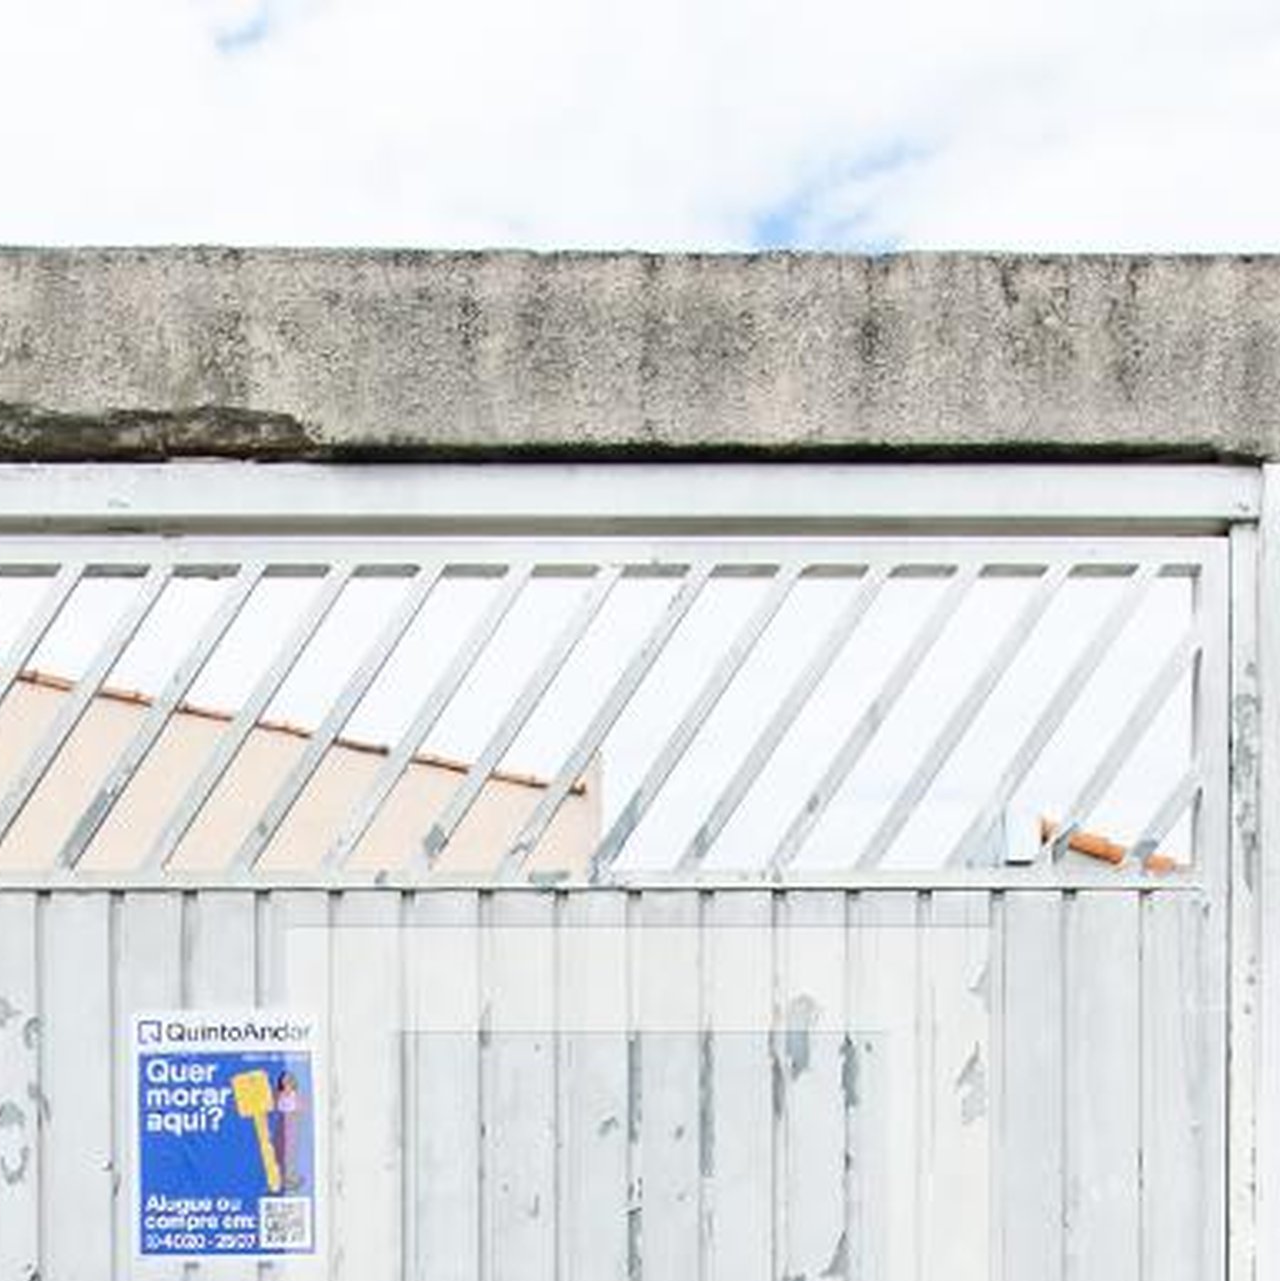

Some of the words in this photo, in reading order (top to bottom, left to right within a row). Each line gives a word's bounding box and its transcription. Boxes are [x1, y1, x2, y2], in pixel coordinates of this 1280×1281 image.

[166, 1023, 310, 1042] QuintoAndar
[146, 1059, 217, 1084] Quer
[147, 1086, 232, 1106] morar
[147, 1107, 224, 1137] aqui?
[146, 1194, 213, 1215] Alugue
